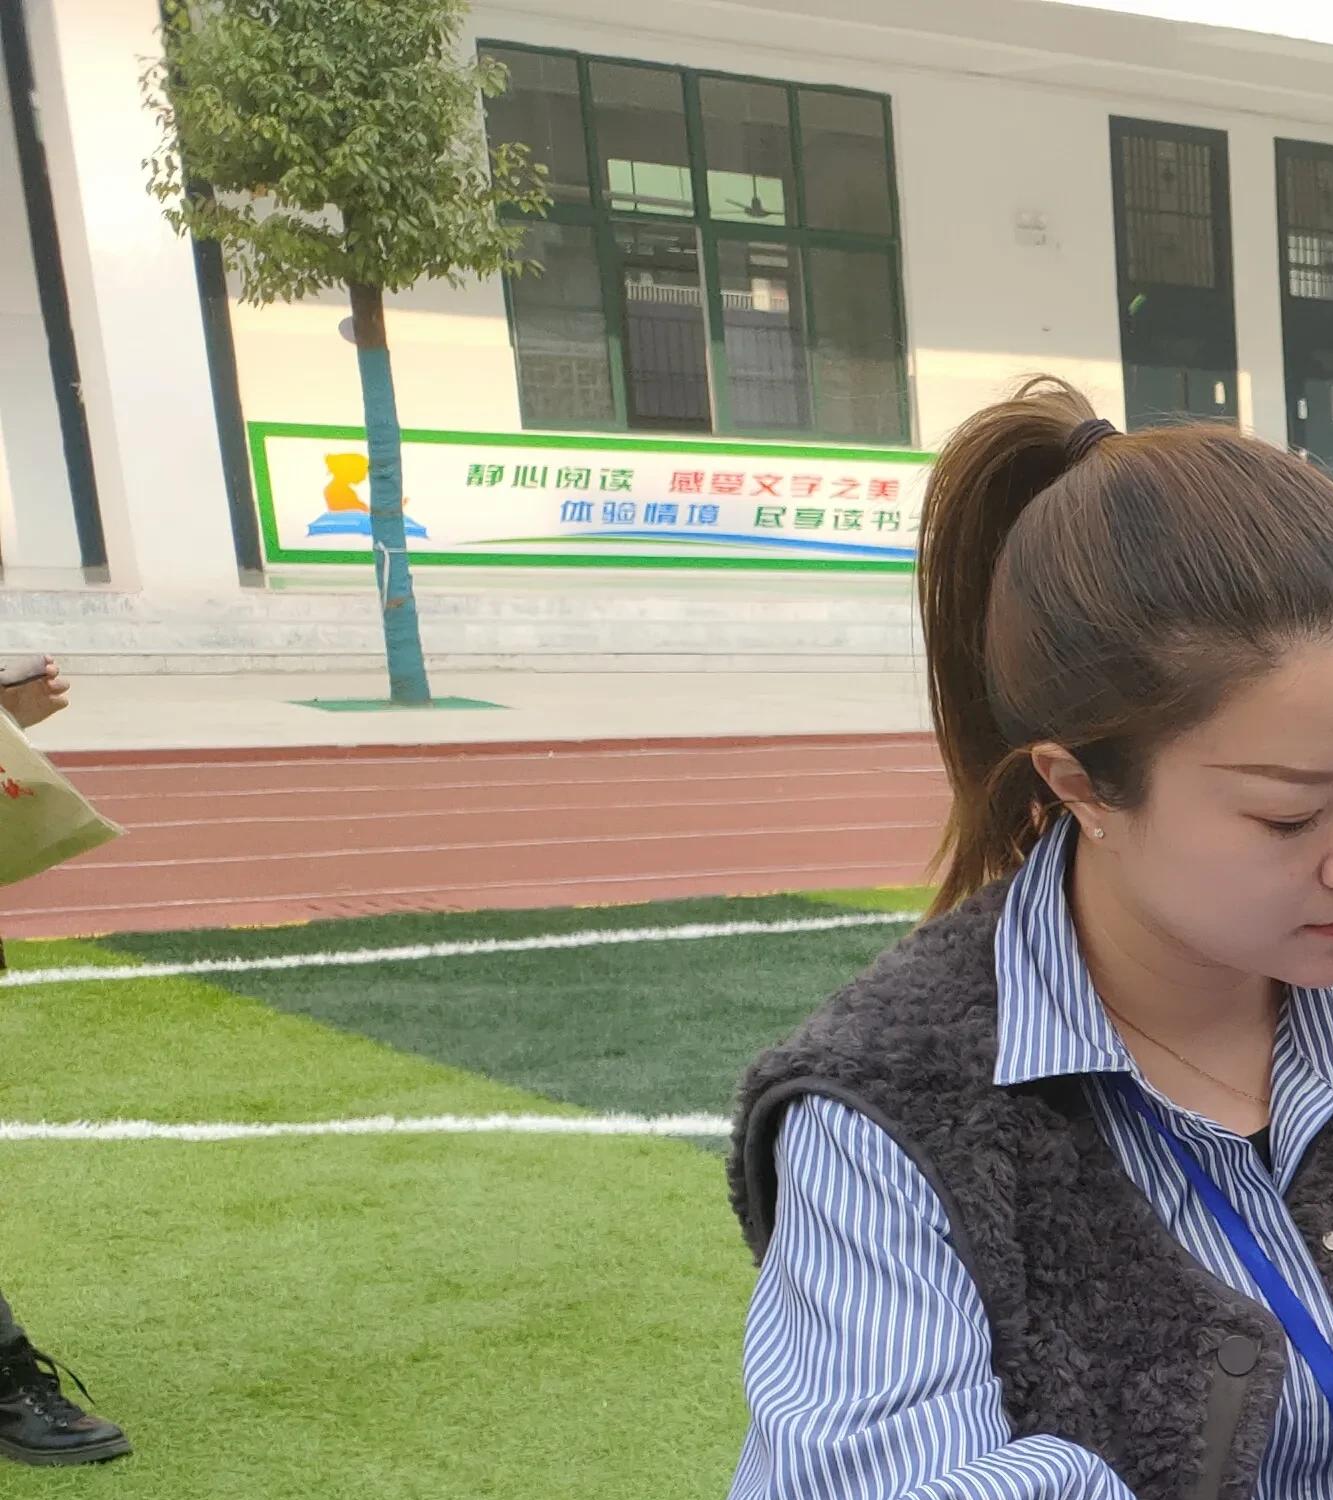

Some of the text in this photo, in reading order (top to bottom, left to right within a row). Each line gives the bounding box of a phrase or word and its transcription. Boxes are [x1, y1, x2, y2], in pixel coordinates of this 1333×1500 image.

[466, 463, 900, 501] 静心阅读 感受文字之美
[559, 499, 721, 526] 体验情境
